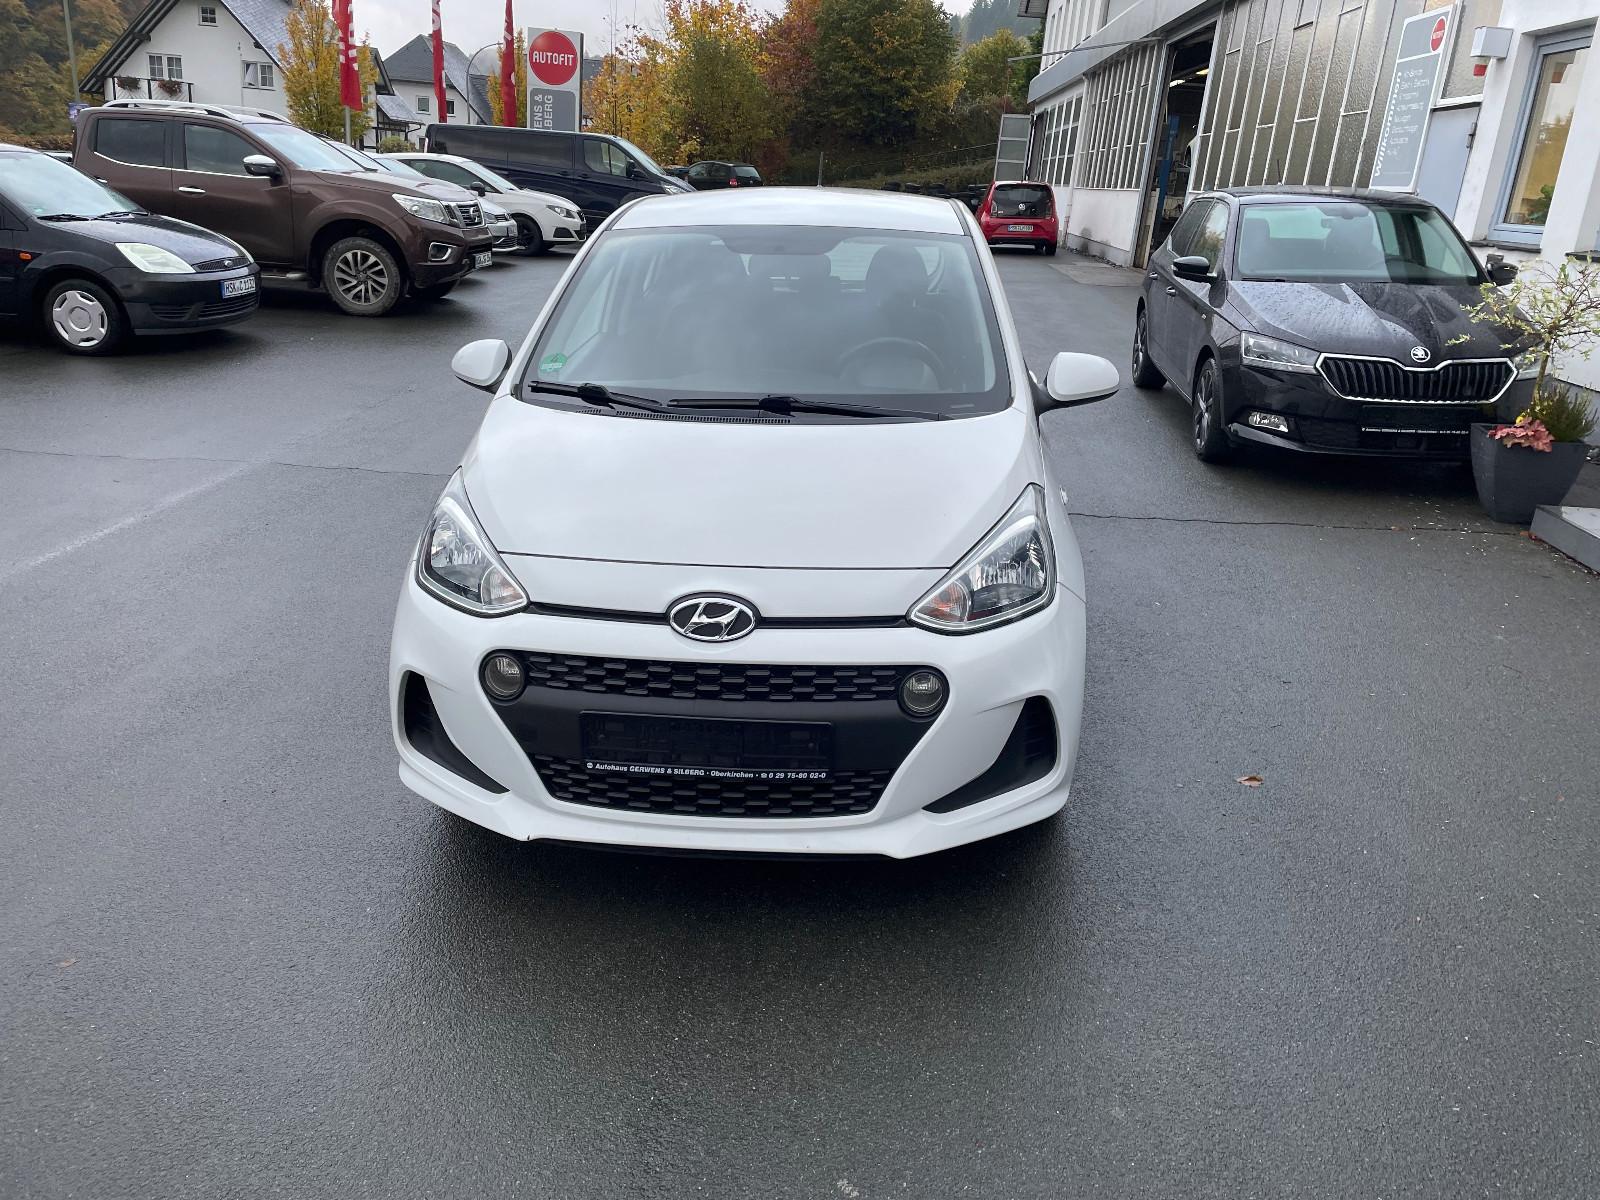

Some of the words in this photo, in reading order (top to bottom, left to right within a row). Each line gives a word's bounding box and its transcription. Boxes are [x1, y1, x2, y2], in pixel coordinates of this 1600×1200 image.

[532, 51, 574, 66] AUTOFIT
[534, 94, 543, 102] &
[533, 105, 543, 129] ENS
[544, 94, 553, 130] BERG
[595, 763, 628, 772] Autohaus
[629, 765, 666, 774] GERWENS
[673, 768, 705, 776] SILBERG
[710, 770, 754, 779] Oberkirchen
